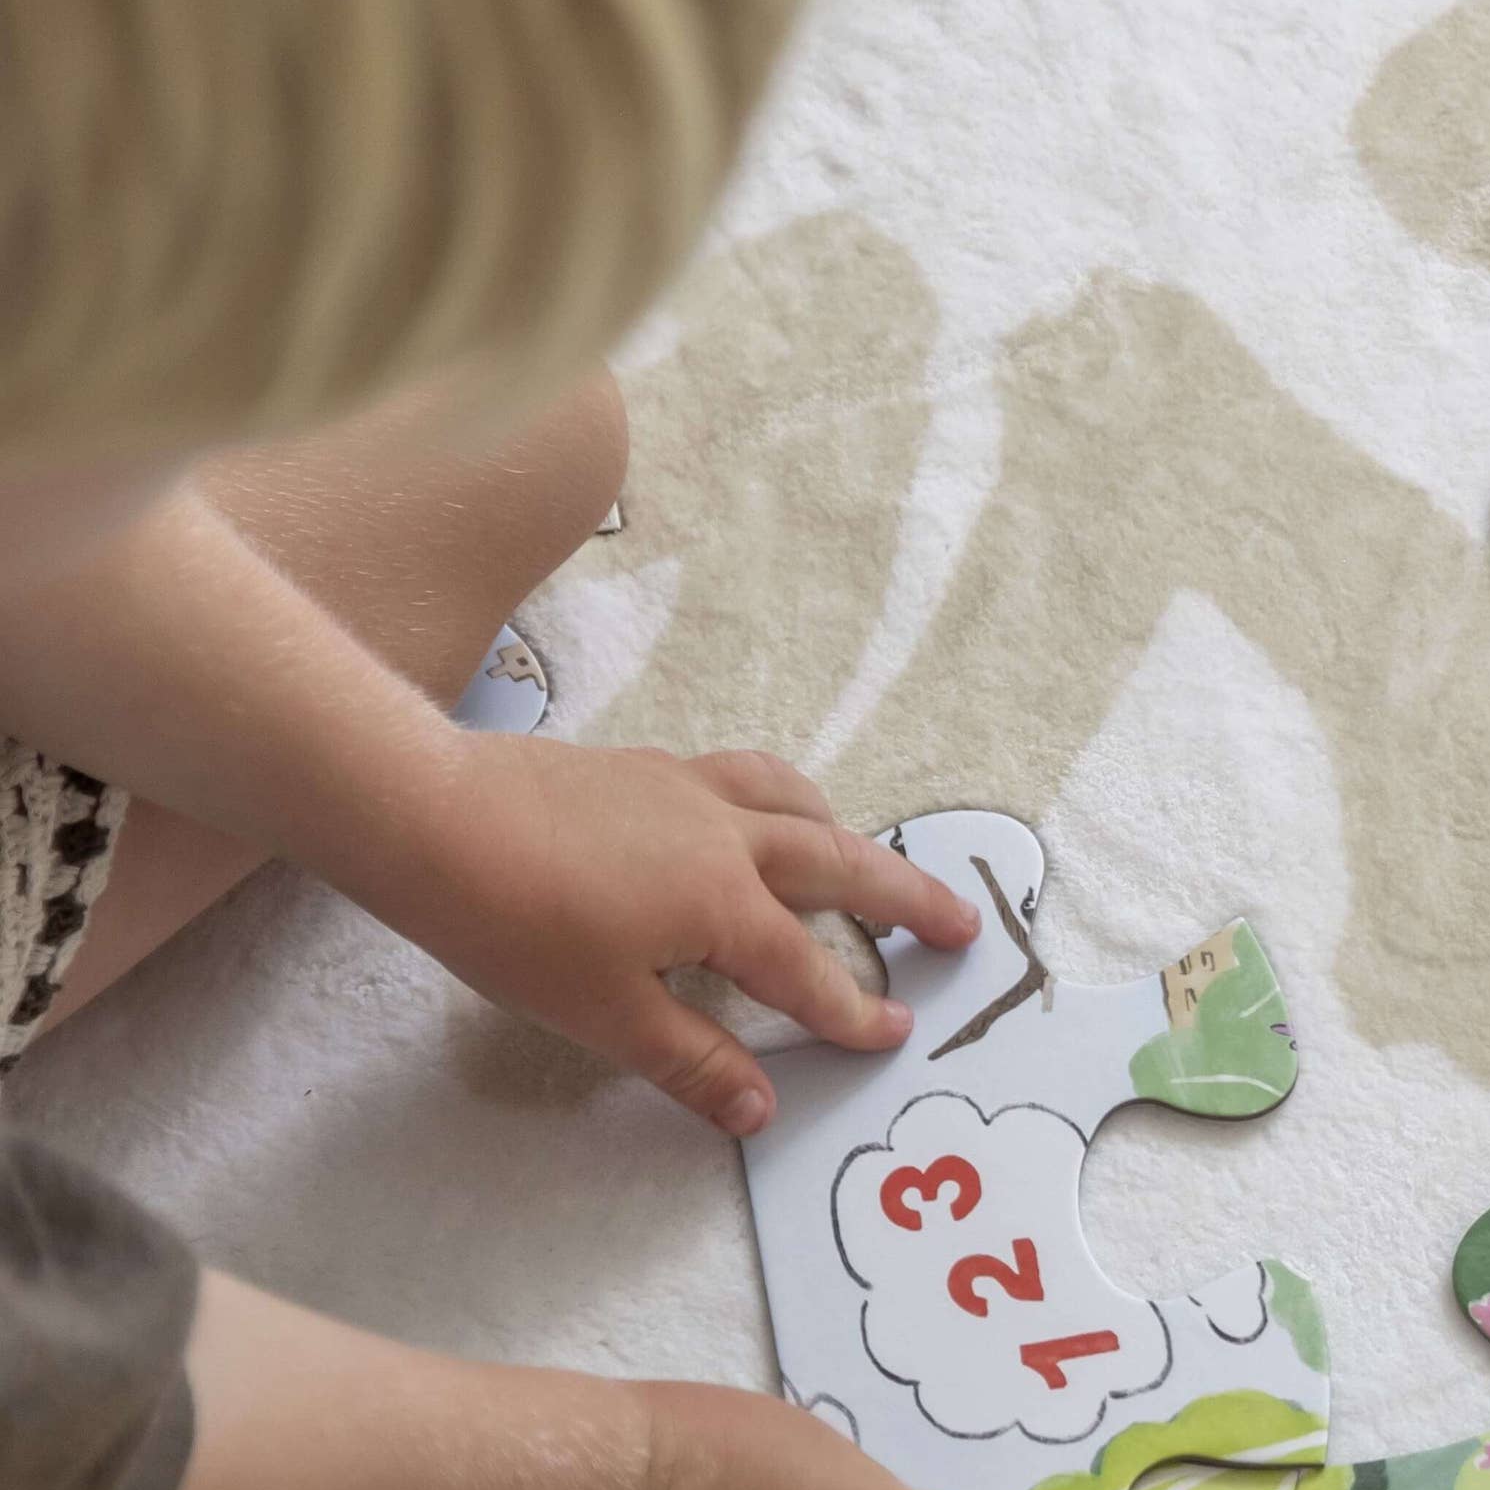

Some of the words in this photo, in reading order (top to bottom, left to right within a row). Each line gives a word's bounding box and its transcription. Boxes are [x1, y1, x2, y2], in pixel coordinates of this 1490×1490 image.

[879, 1154, 982, 1231] 3
[947, 1238, 1045, 1317] 2
[1020, 1330, 1119, 1389] 1
